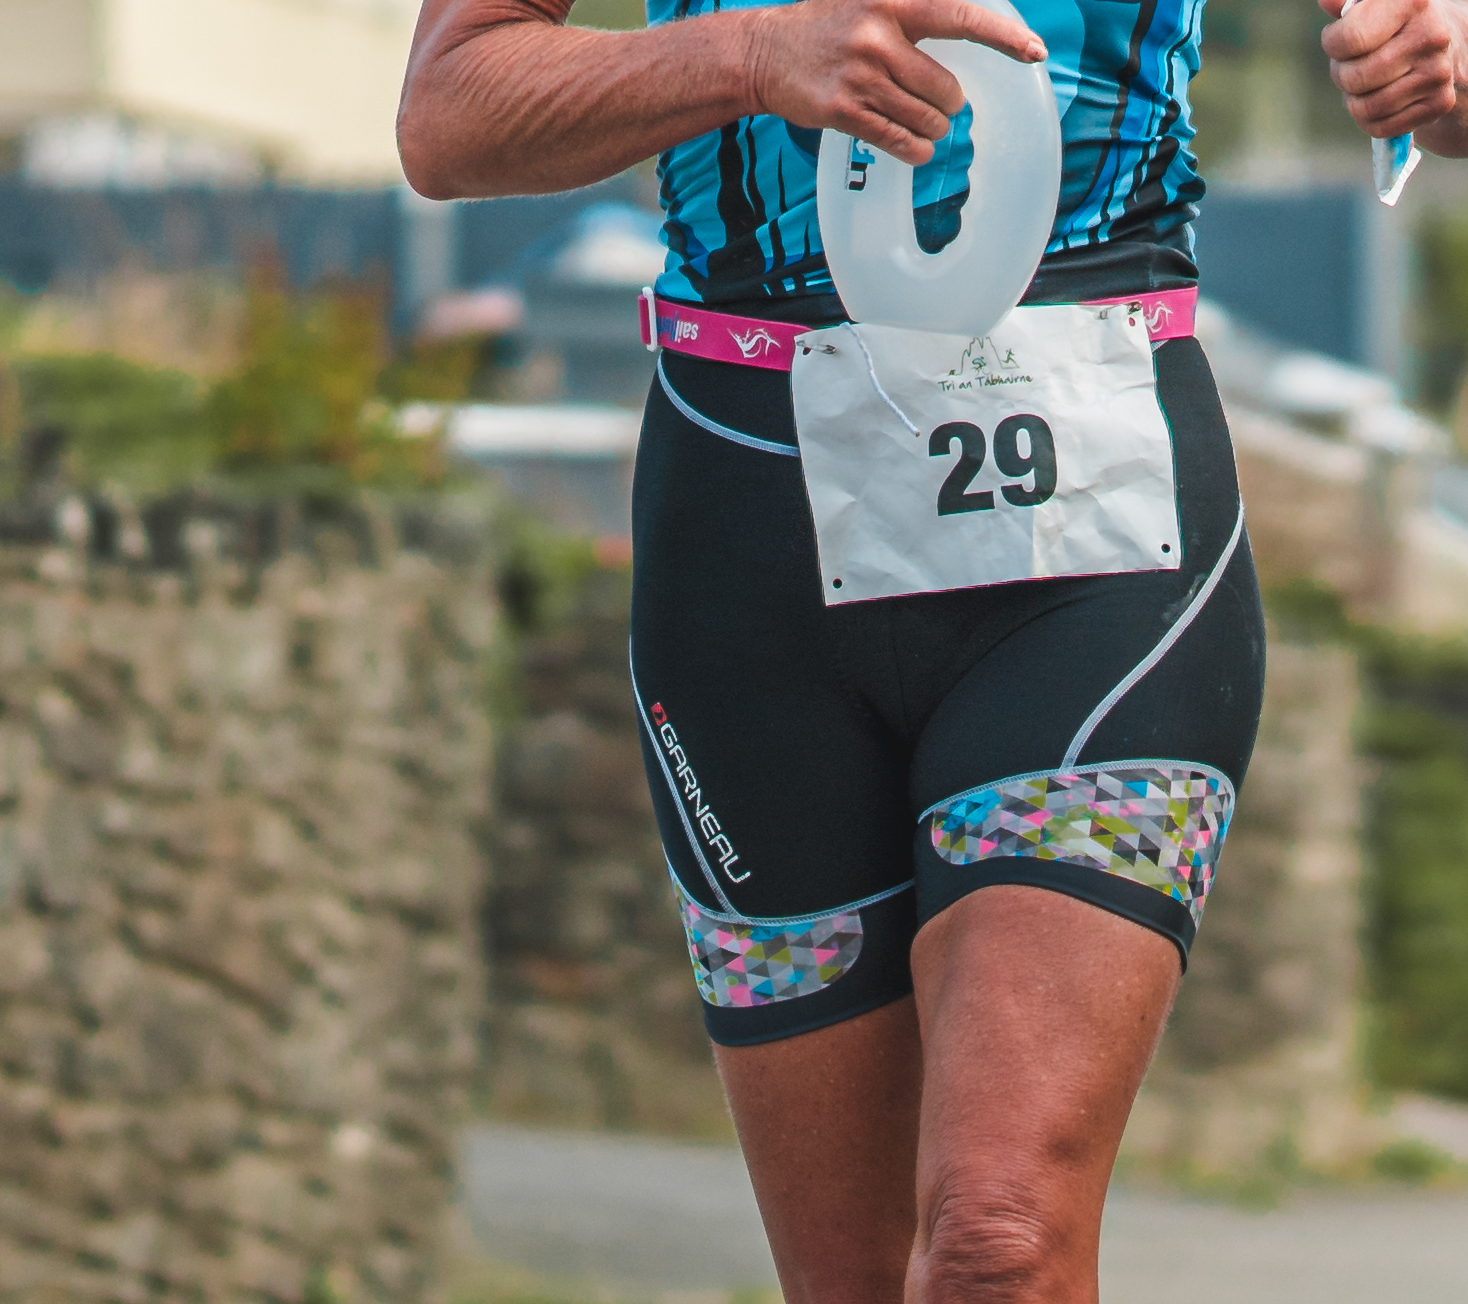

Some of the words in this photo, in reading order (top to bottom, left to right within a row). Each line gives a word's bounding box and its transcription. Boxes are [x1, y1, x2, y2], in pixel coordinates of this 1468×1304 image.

[939, 381, 955, 392] Tri
[959, 382, 972, 390] an
[929, 414, 1057, 516] 29
[660, 723, 751, 883] GARNEAU
